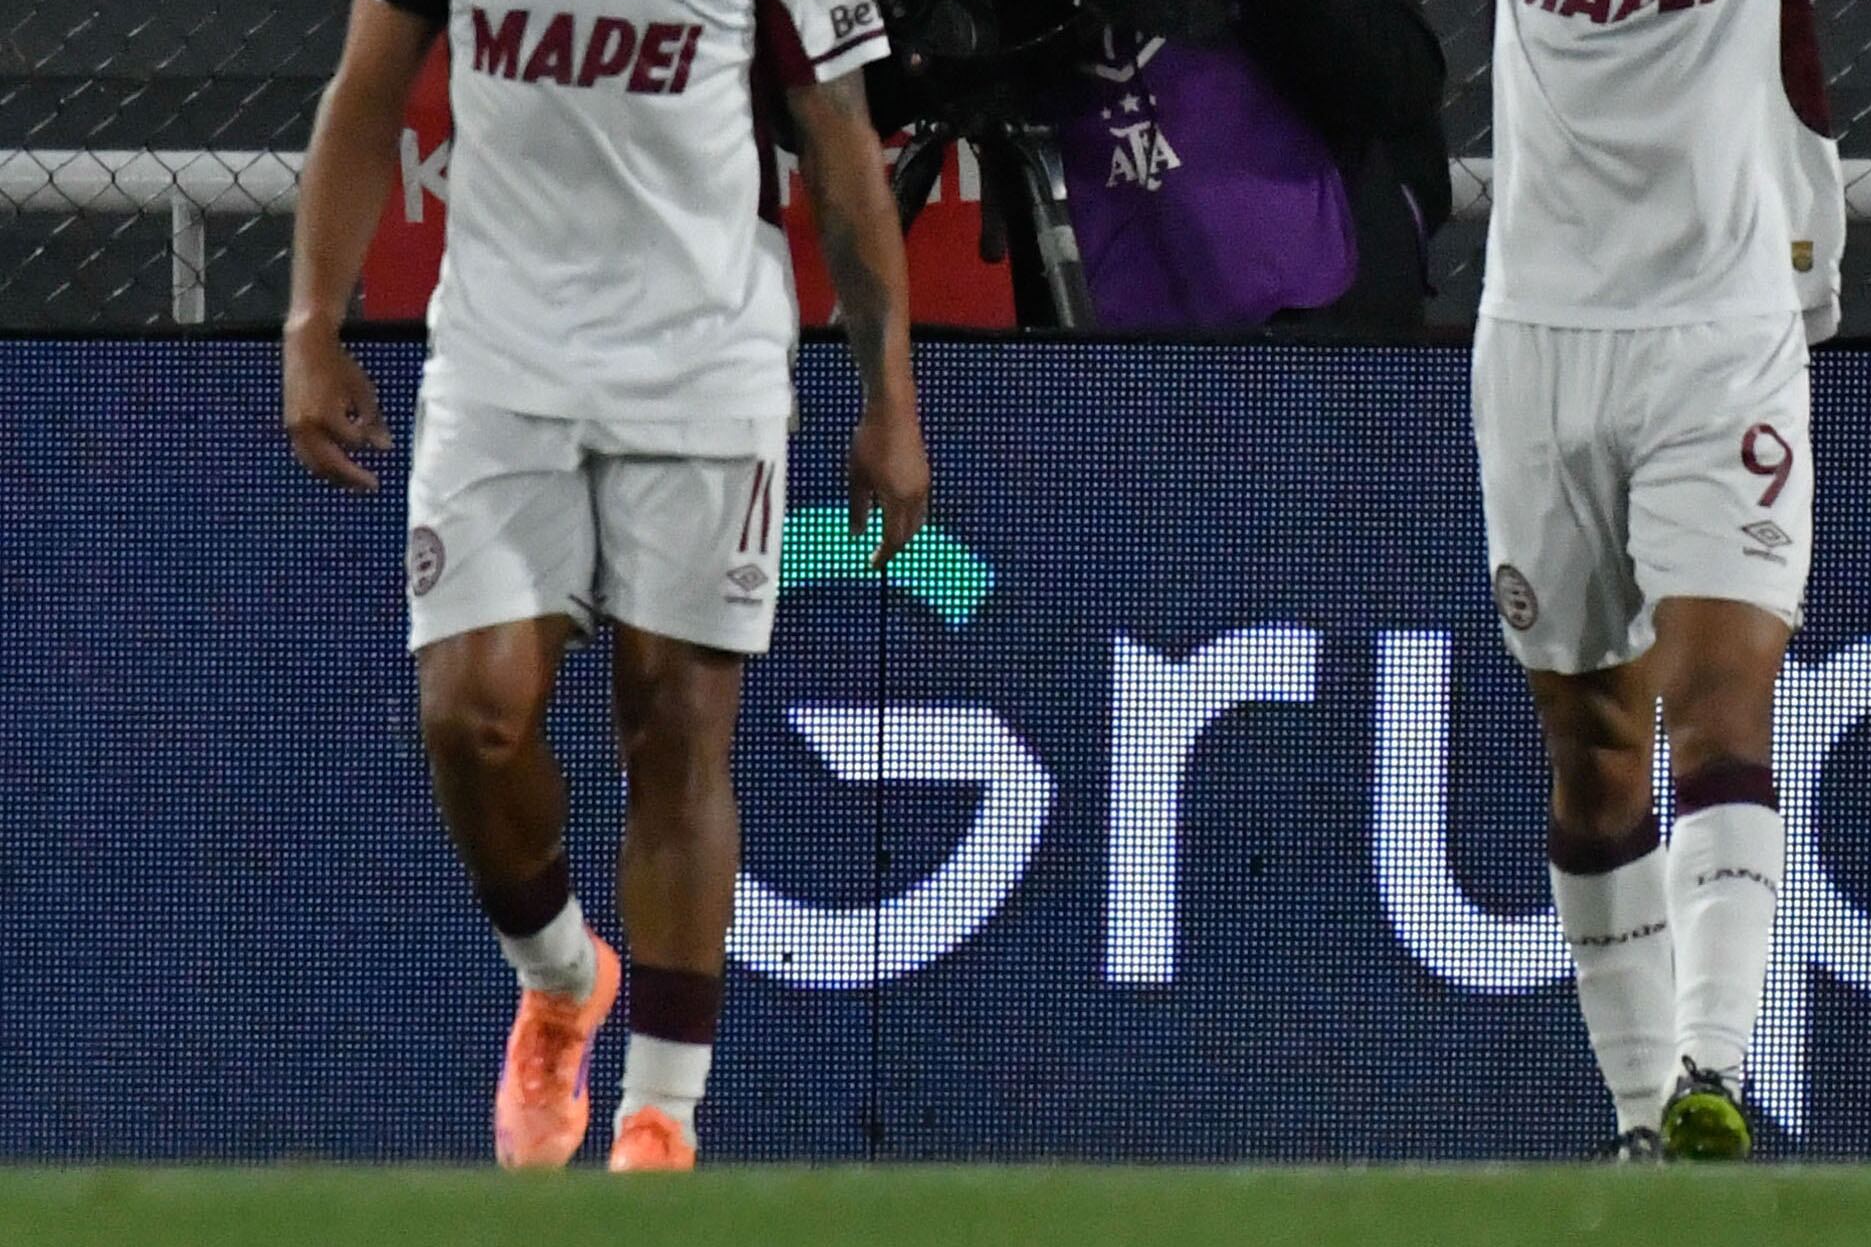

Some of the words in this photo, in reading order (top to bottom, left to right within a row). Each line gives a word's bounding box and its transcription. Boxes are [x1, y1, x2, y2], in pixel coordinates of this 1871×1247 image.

[472, 6, 704, 95] MAPEI
[830, 2, 882, 39] Be
[737, 460, 776, 554] 11
[1741, 422, 1794, 508] 9
